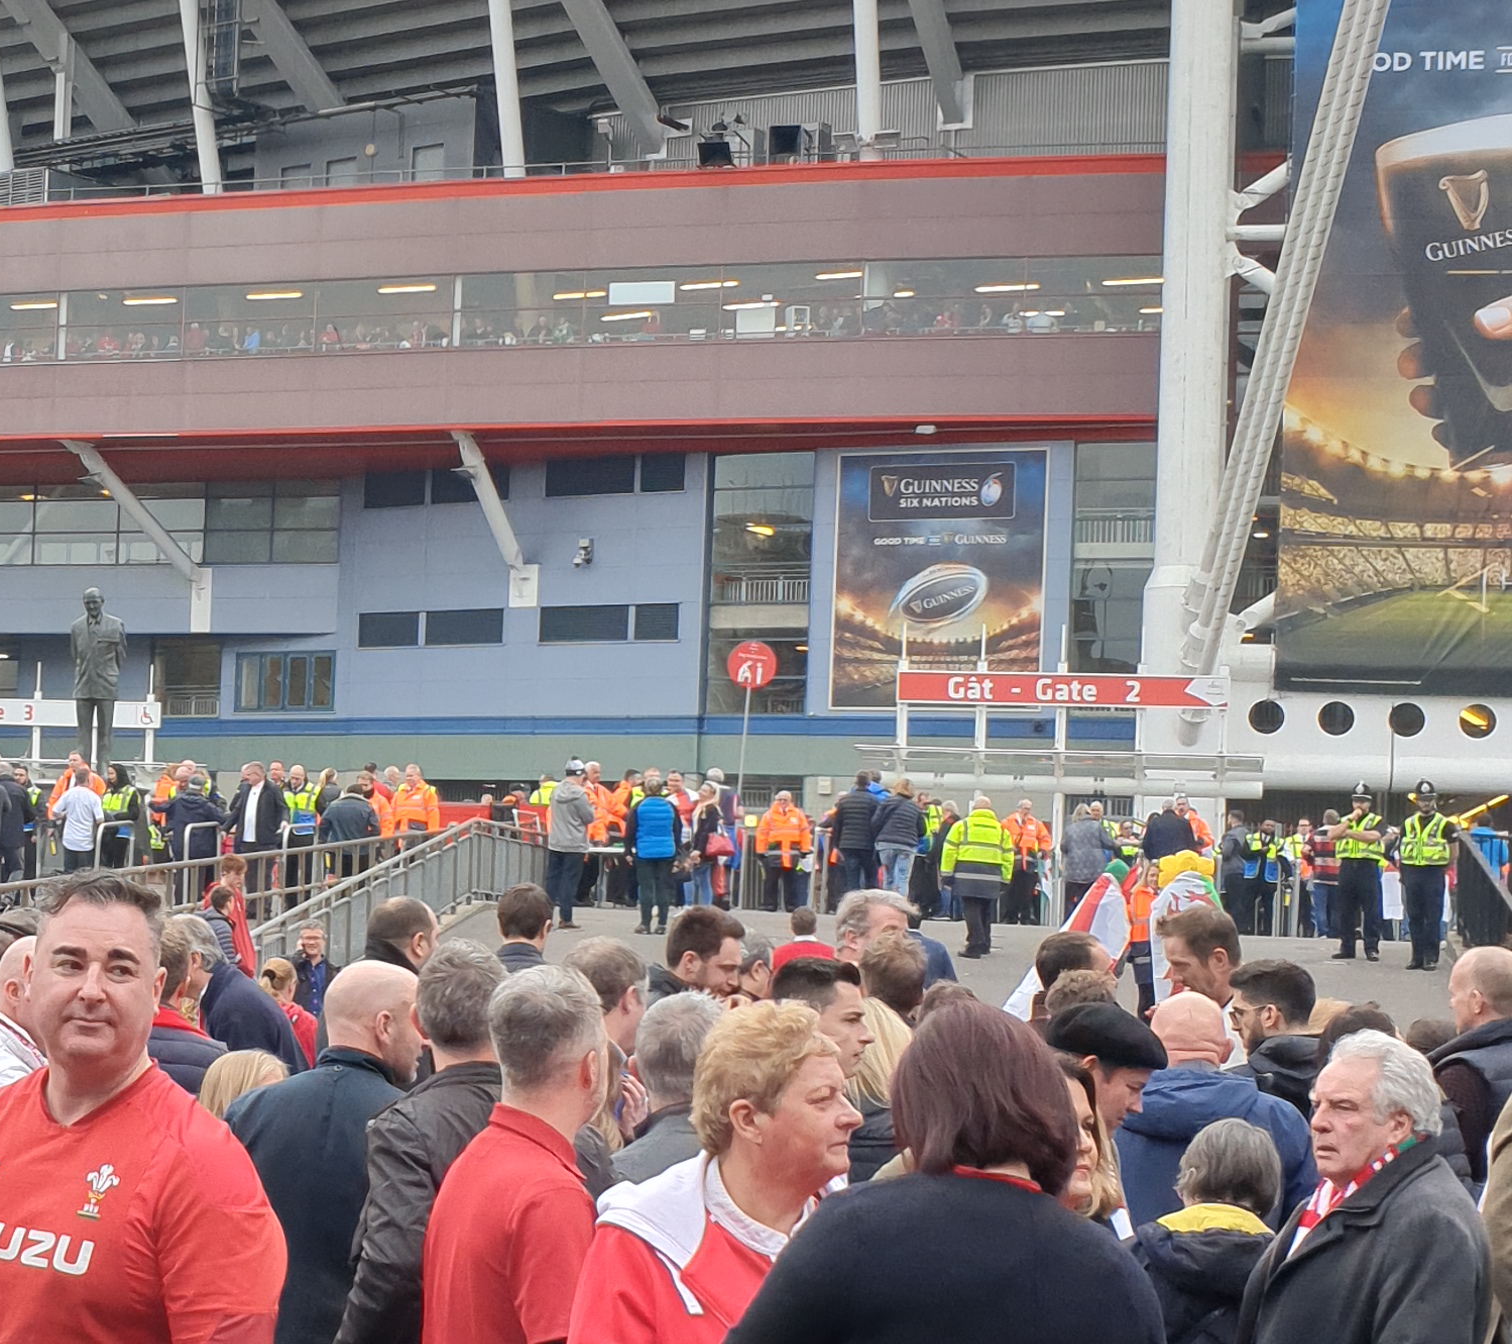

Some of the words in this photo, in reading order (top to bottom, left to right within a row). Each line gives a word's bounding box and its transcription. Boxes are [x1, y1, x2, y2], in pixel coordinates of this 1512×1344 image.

[1372, 51, 1413, 72] OD
[1419, 50, 1485, 71] TIME
[899, 478, 979, 494] GUINNESS
[899, 498, 919, 508] SIX
[922, 496, 979, 508] NATIONS
[947, 676, 994, 701] Gât
[1035, 678, 1098, 702] Gate
[1125, 680, 1141, 702] 2
[24, 705, 34, 721] 3
